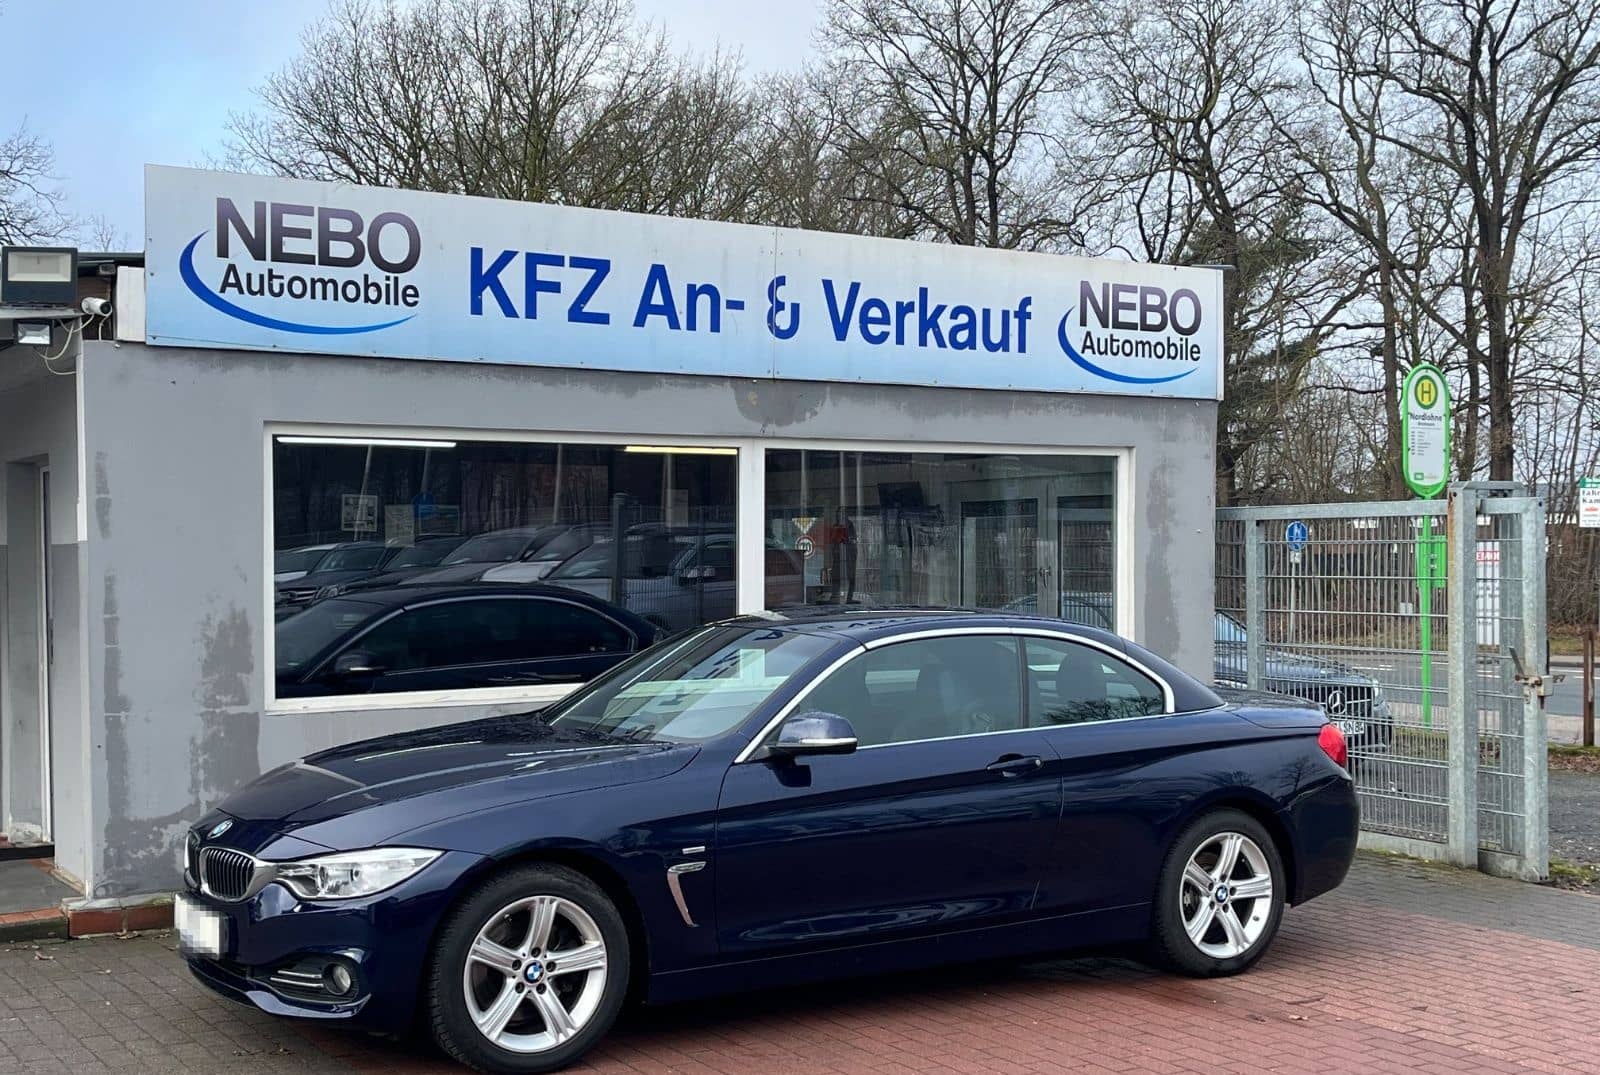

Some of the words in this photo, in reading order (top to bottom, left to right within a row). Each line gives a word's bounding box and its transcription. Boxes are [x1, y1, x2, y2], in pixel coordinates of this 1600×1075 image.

[216, 197, 421, 274] NEBO
[219, 263, 420, 307] Automobile
[470, 246, 611, 325] KFZ
[632, 263, 745, 333] An-
[767, 275, 800, 340] &
[821, 278, 1032, 353] Verkauf
[1079, 280, 1202, 336] NEBO
[1081, 330, 1201, 361] Automobile
[1421, 382, 1431, 402] H
